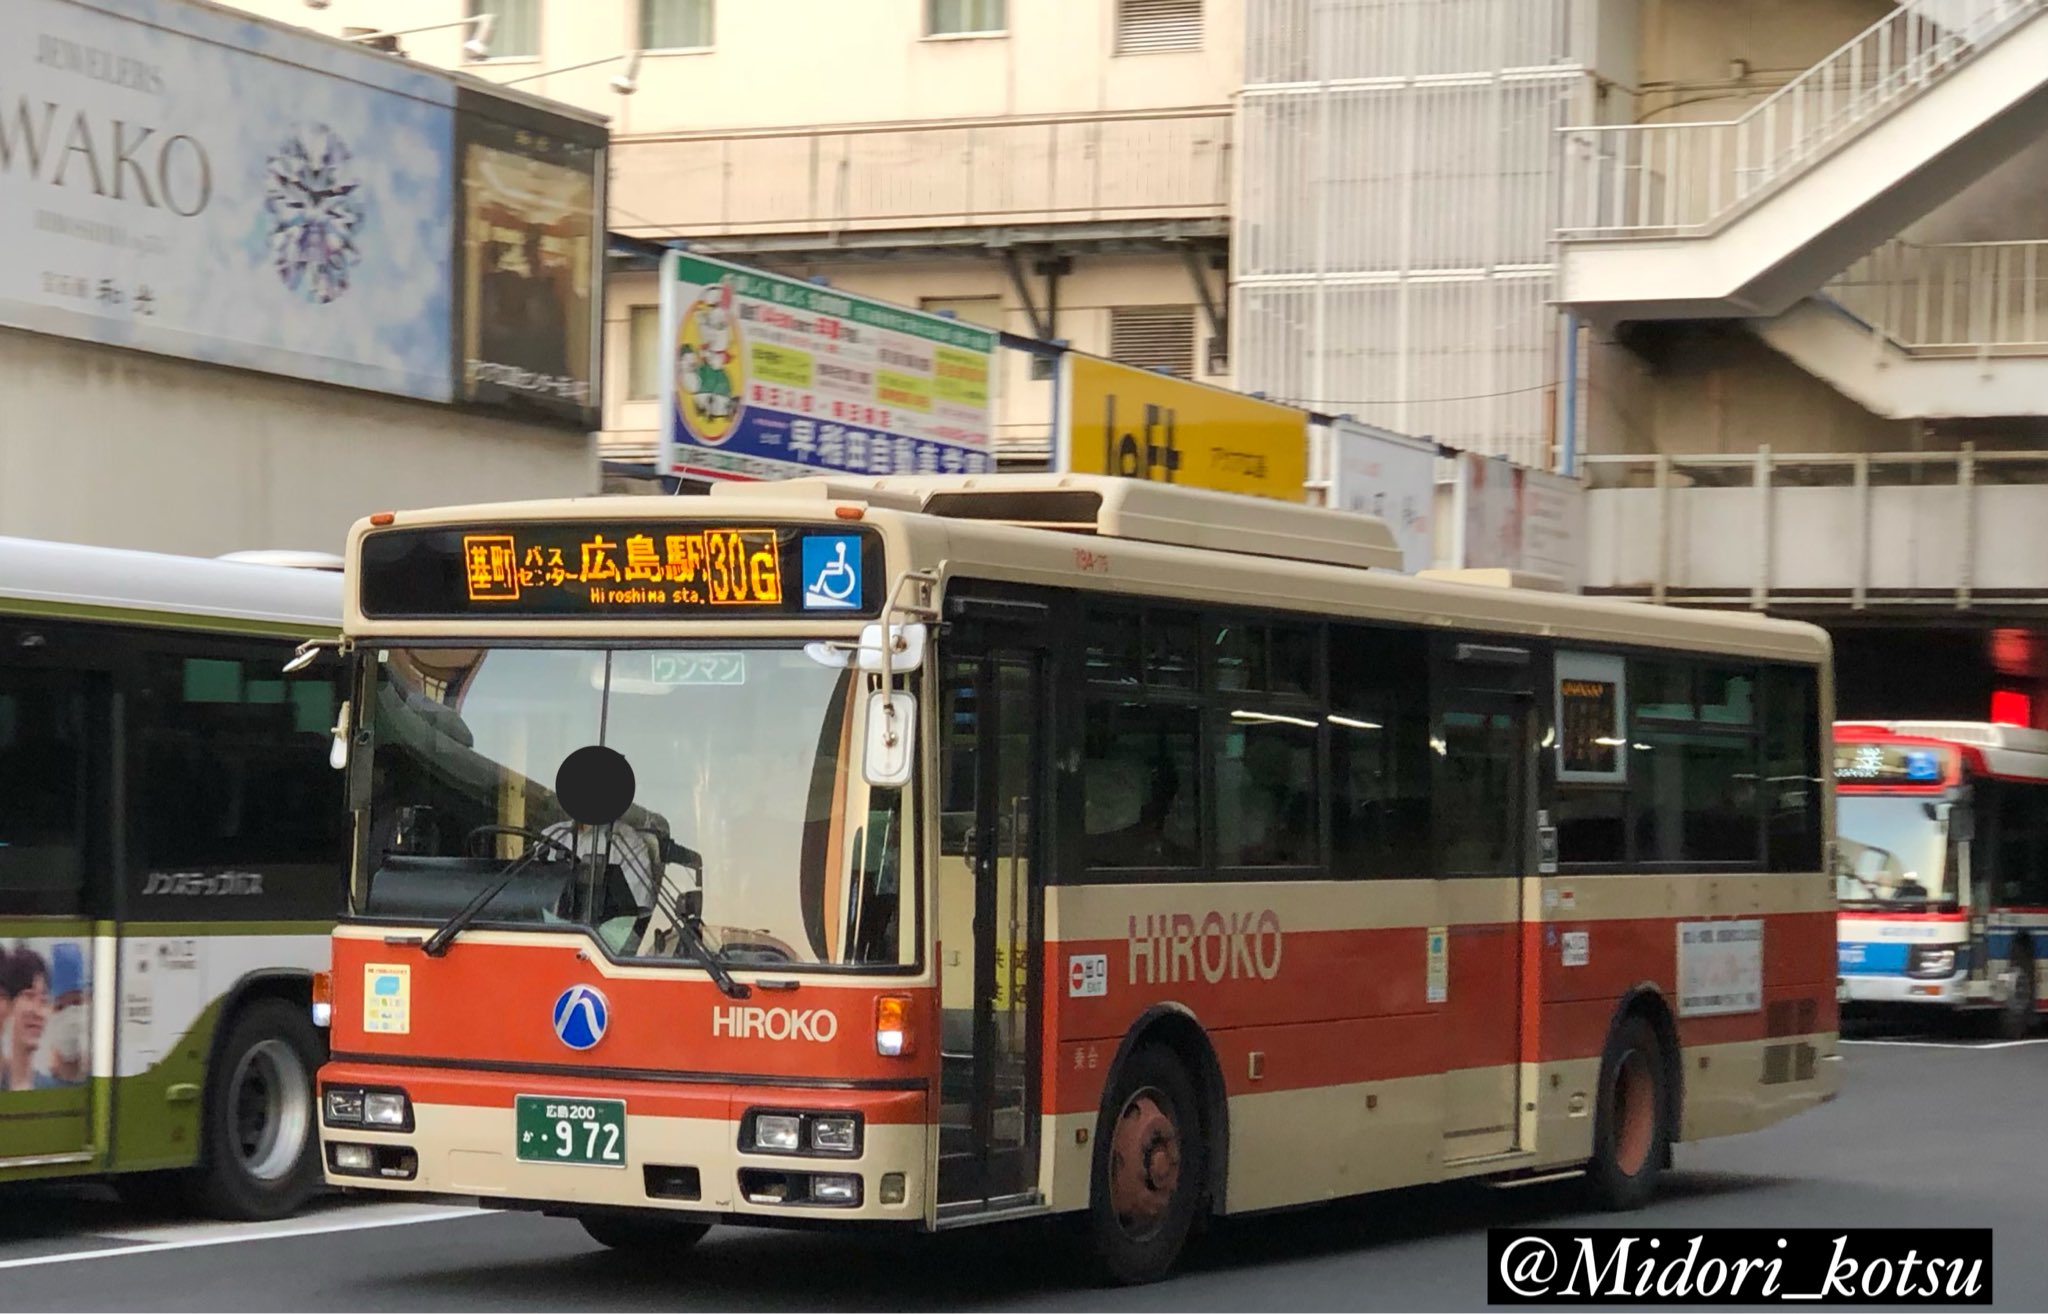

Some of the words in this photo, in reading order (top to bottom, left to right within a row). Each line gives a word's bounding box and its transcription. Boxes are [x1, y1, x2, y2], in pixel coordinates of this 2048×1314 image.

[0, 94, 214, 217] WAKO
[470, 545, 511, 589] 基町
[525, 545, 564, 567] バス
[580, 534, 706, 583] 広島駅
[517, 567, 578, 588] センター
[590, 587, 666, 604] Hiroshima
[673, 589, 705, 605] sta.
[657, 656, 740, 681] ワンマン
[1128, 909, 1282, 985] HIROKO
[713, 1006, 838, 1043] HIROKO
